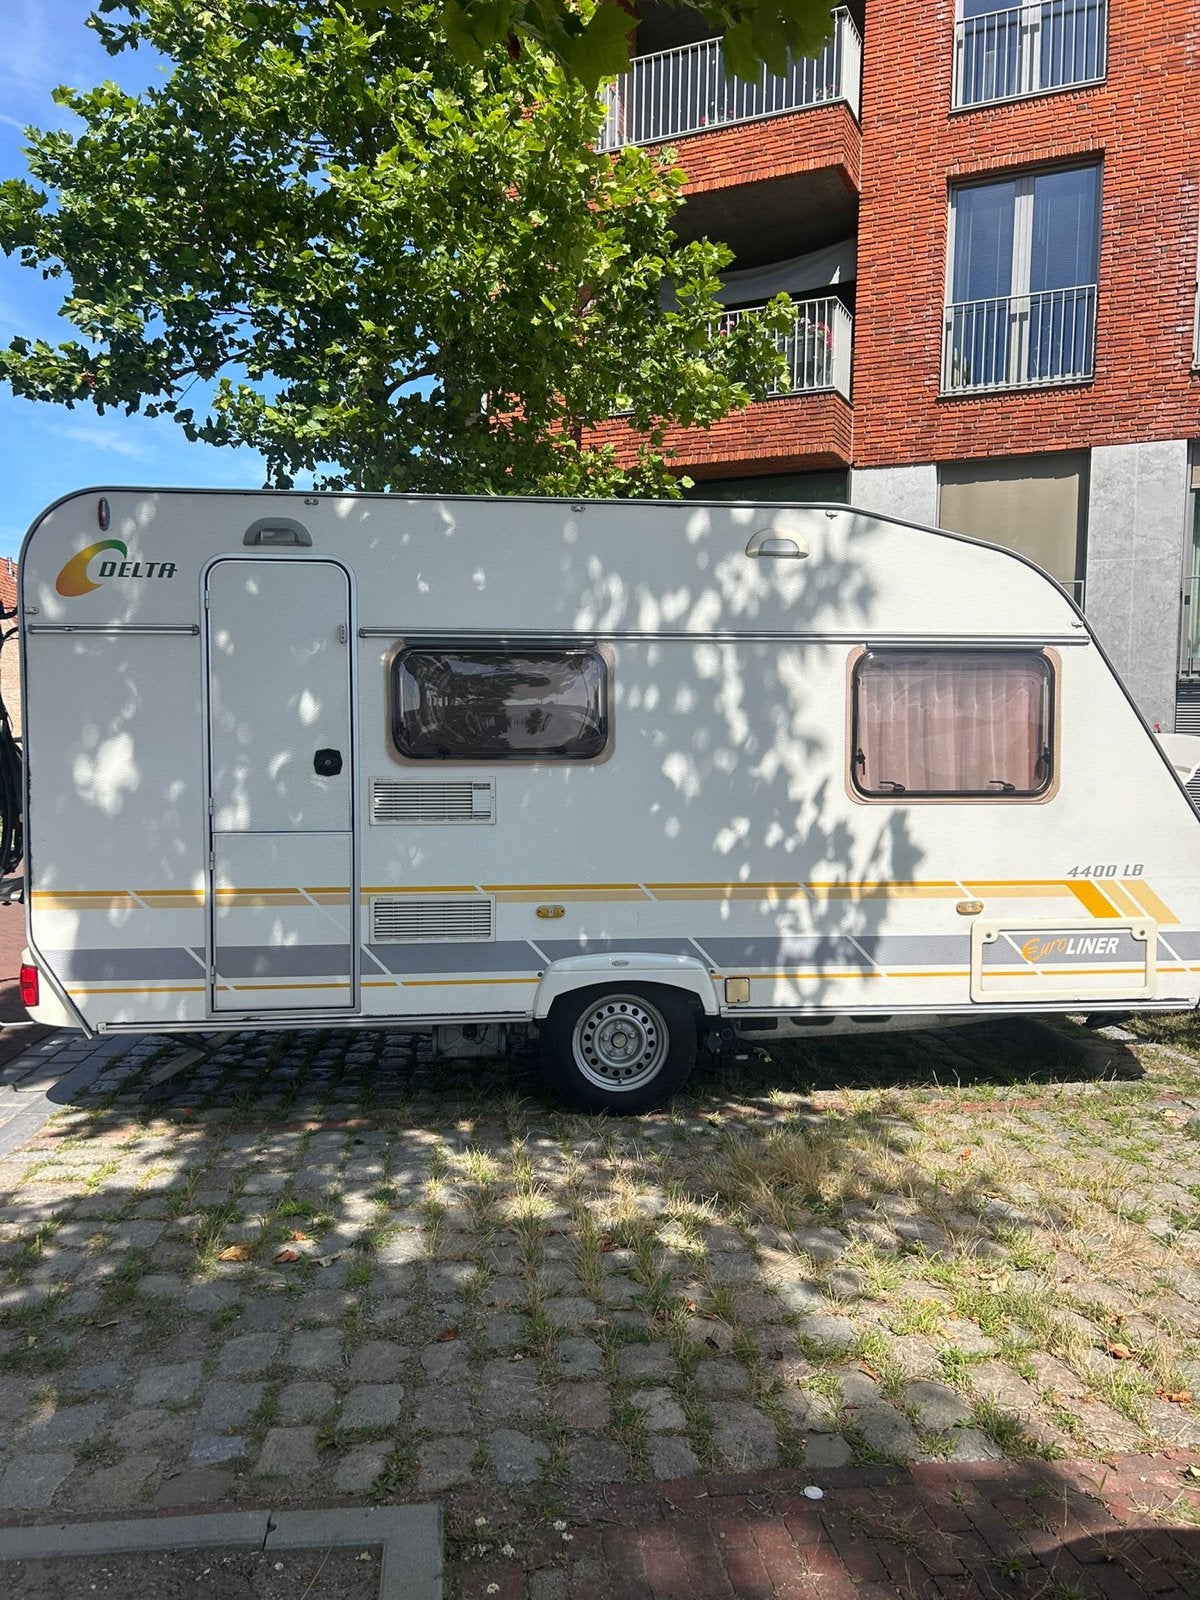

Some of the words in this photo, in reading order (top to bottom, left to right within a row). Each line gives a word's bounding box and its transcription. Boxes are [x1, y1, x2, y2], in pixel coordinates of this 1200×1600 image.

[99, 561, 178, 578] DELTA
[1066, 864, 1117, 878] 4400
[1123, 863, 1144, 877] LB
